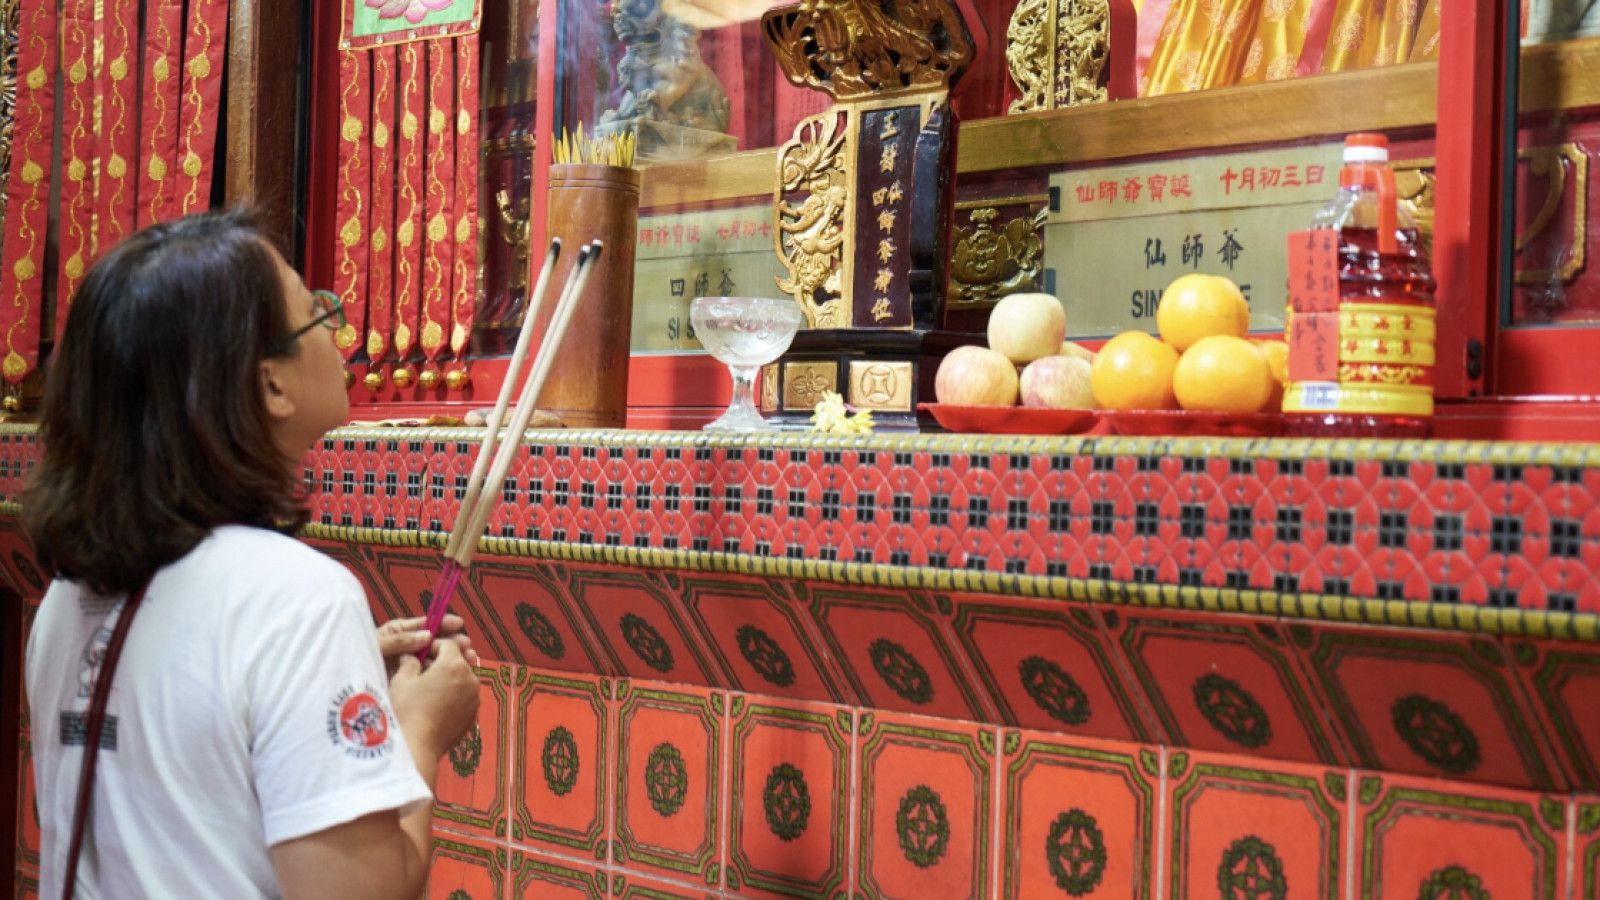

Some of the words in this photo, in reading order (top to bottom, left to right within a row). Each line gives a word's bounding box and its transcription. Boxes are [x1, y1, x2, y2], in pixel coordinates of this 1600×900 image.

[1219, 164, 1326, 196] 十月初三日
[1144, 228, 1245, 270] 仙師爺
[667, 316, 680, 340] SI
